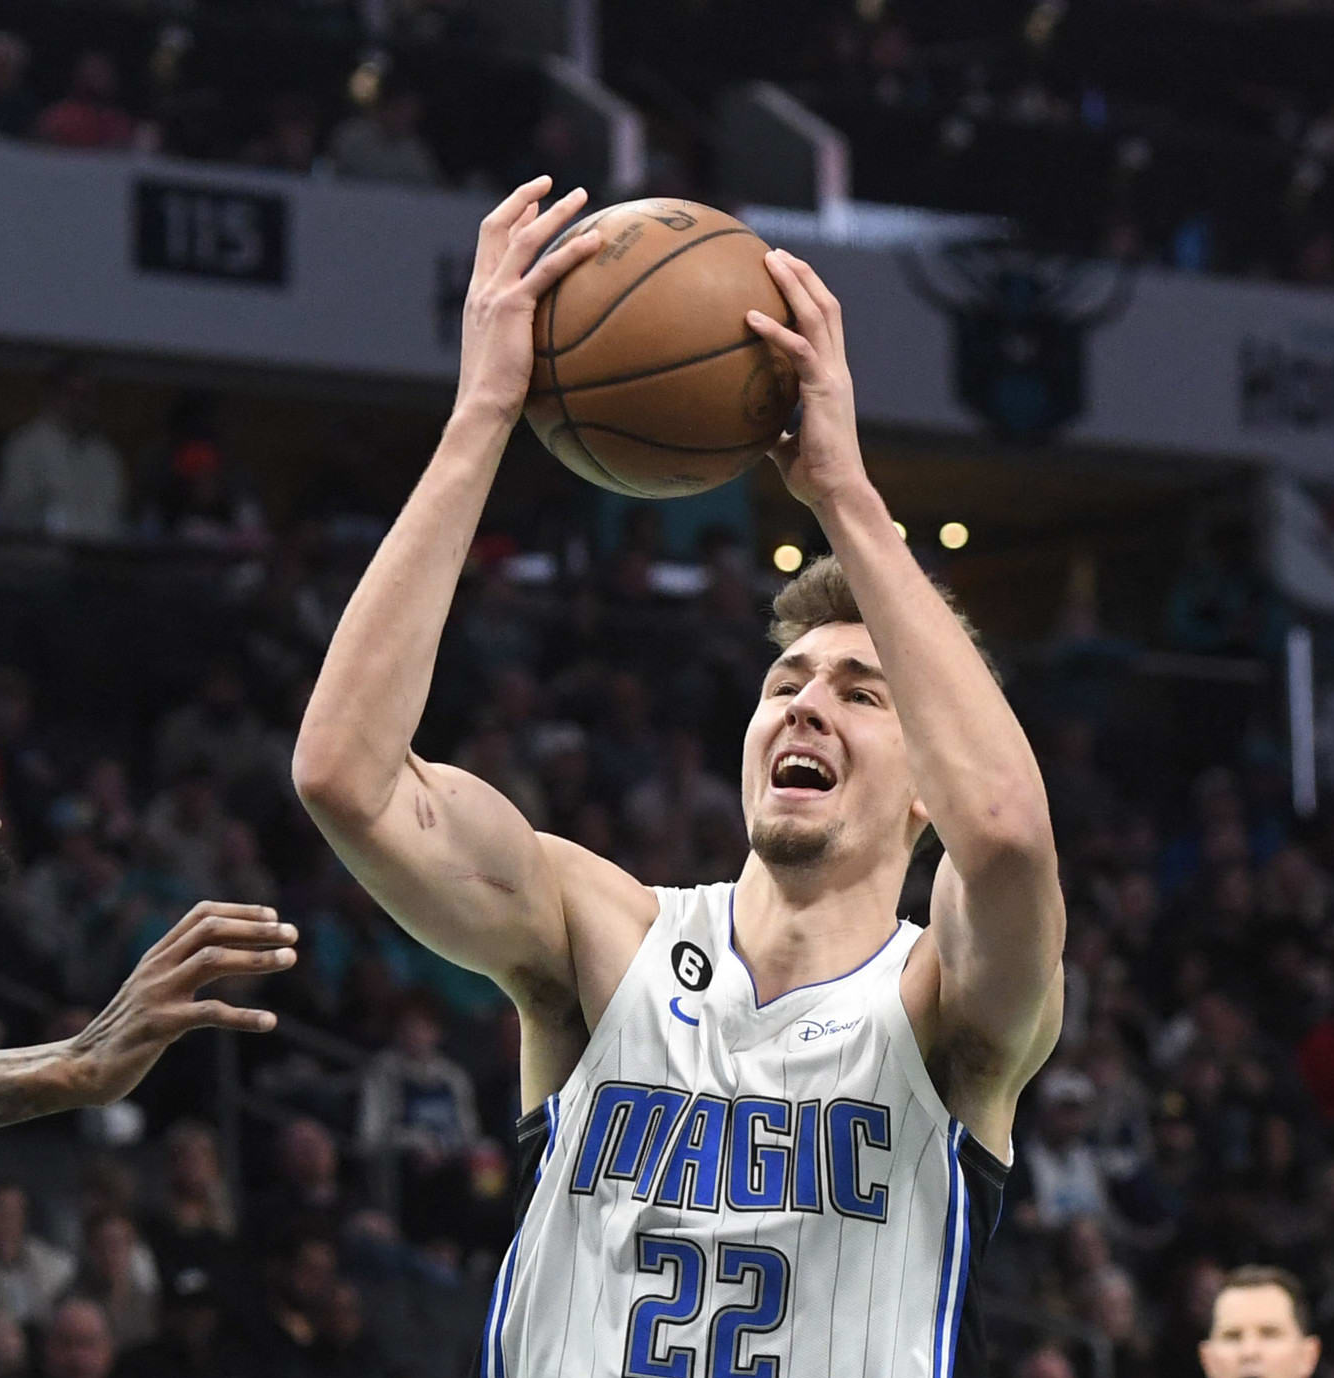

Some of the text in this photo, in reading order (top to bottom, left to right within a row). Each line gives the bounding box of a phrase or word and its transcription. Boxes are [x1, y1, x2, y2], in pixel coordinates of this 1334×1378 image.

[164, 191, 263, 273] 115
[678, 947, 705, 986] 6
[569, 1080, 891, 1225] MAGIC
